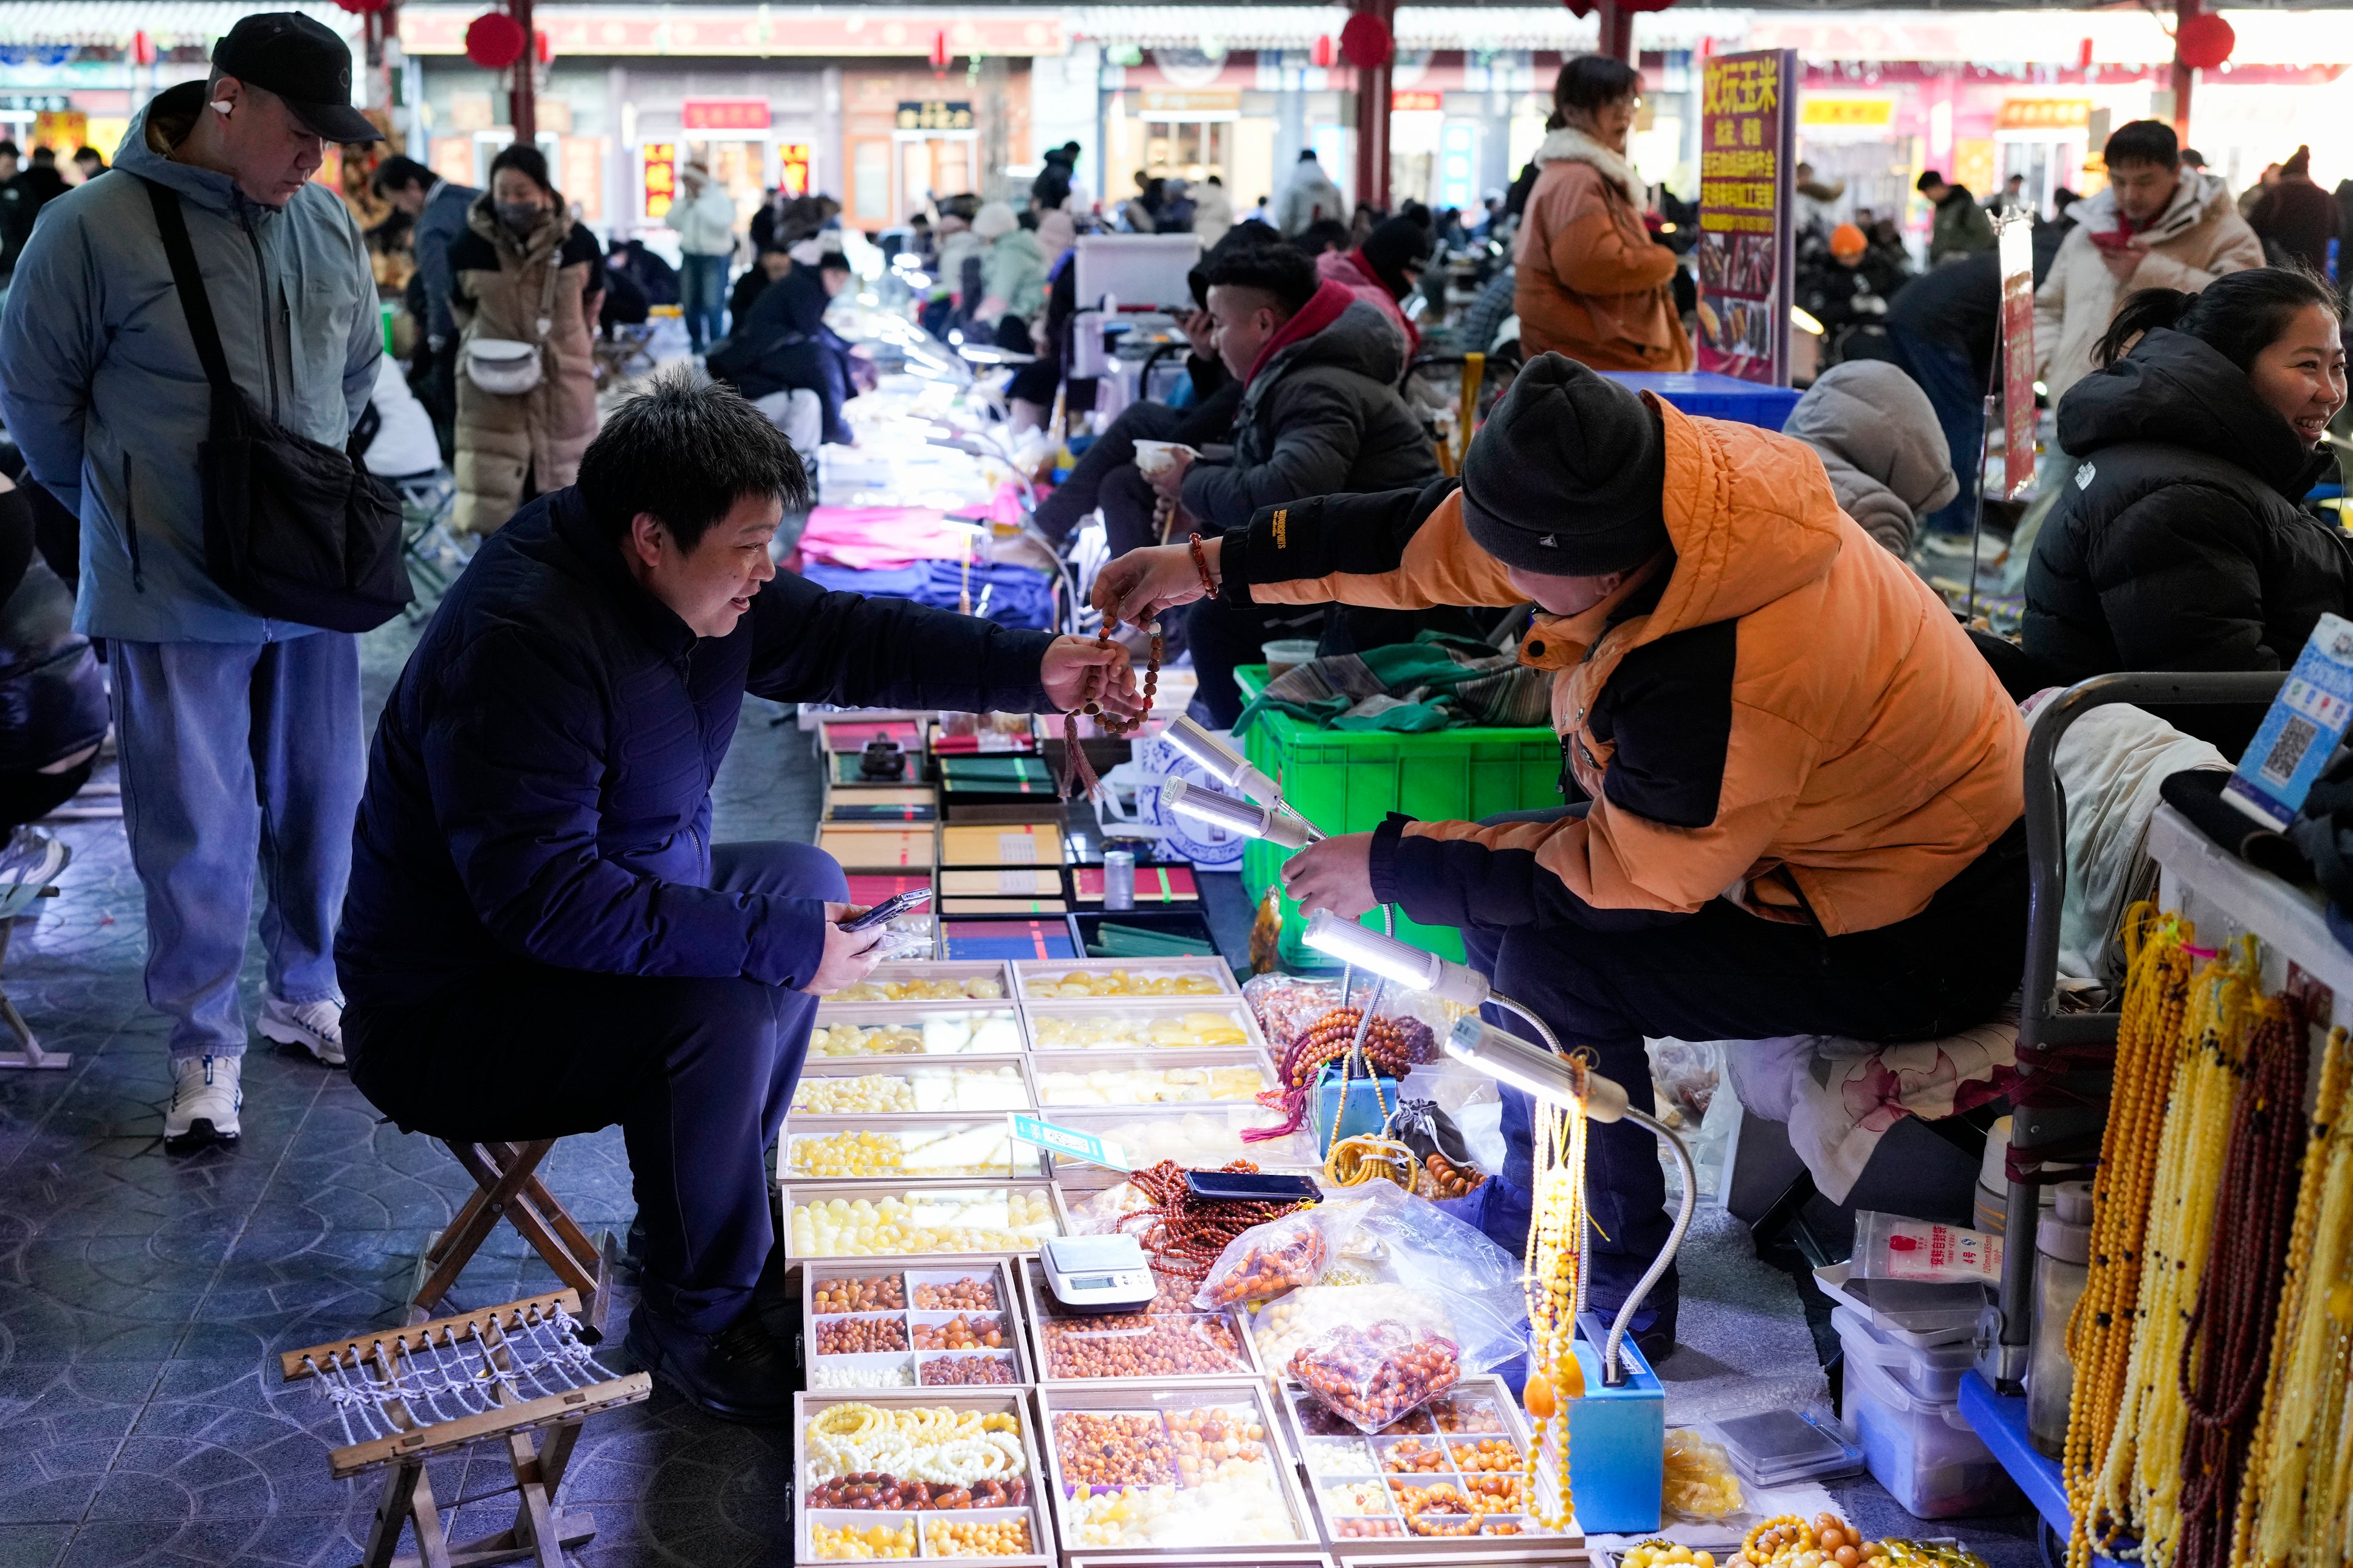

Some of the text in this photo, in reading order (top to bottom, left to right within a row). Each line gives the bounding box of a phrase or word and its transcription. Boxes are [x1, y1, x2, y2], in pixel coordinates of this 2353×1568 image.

[1703, 56, 1778, 115] 文玩玉米
[1930, 1224, 1947, 1266] 保鲜自封袋
[1963, 1251, 1976, 1264] 4号
[1994, 1249, 2003, 1264] 100个
